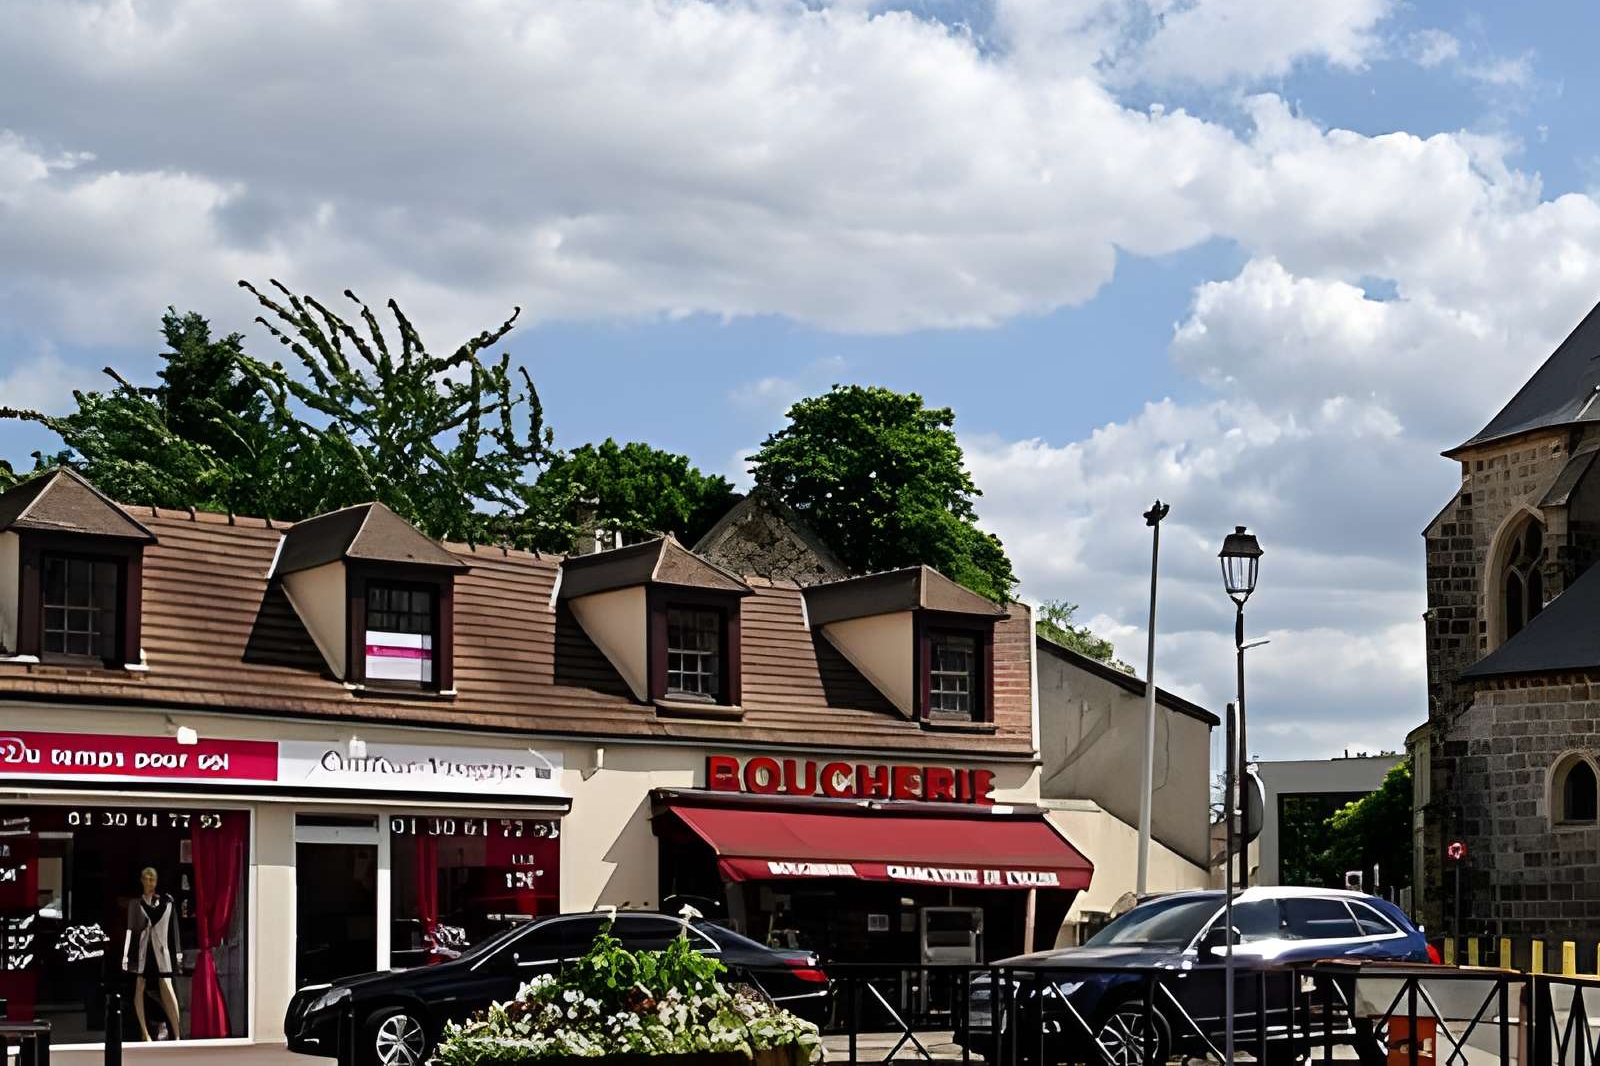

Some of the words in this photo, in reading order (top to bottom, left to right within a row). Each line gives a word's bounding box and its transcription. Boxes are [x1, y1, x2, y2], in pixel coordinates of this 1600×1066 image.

[705, 756, 996, 806] BOUCHERIE
[68, 811, 92, 826] 01
[392, 818, 416, 835] 01
